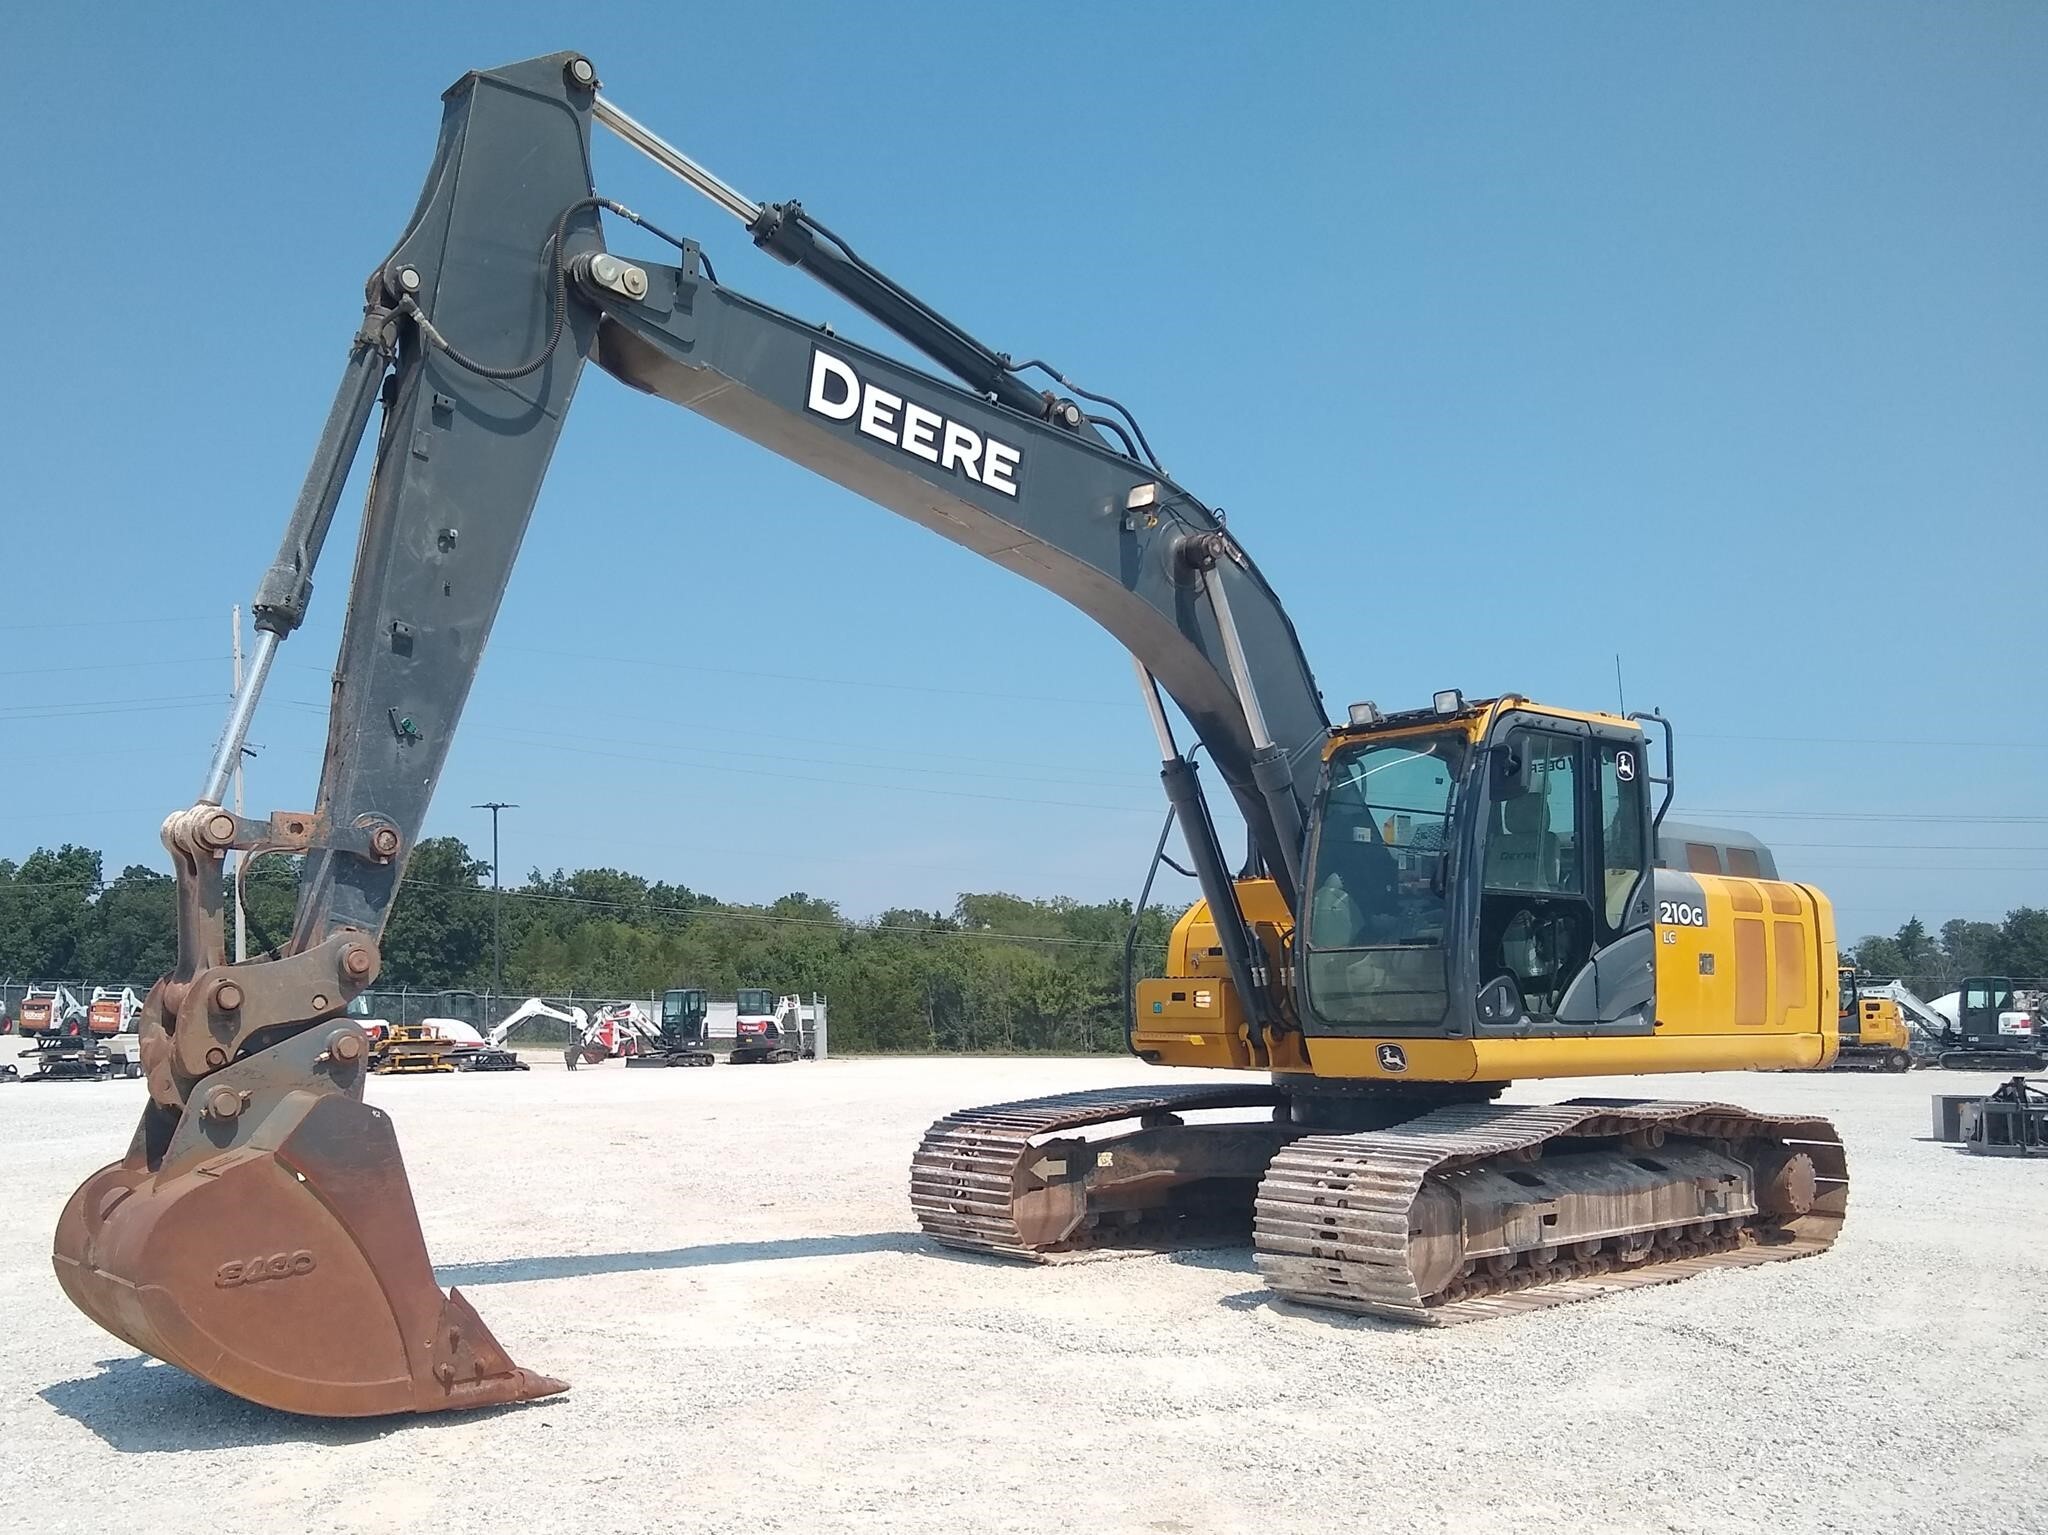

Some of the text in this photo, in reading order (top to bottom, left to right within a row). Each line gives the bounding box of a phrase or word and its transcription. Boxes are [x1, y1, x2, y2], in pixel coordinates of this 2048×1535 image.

[808, 349, 1021, 497] DEERE
[1660, 901, 1703, 926] 210G
[1663, 931, 1676, 944] LC
